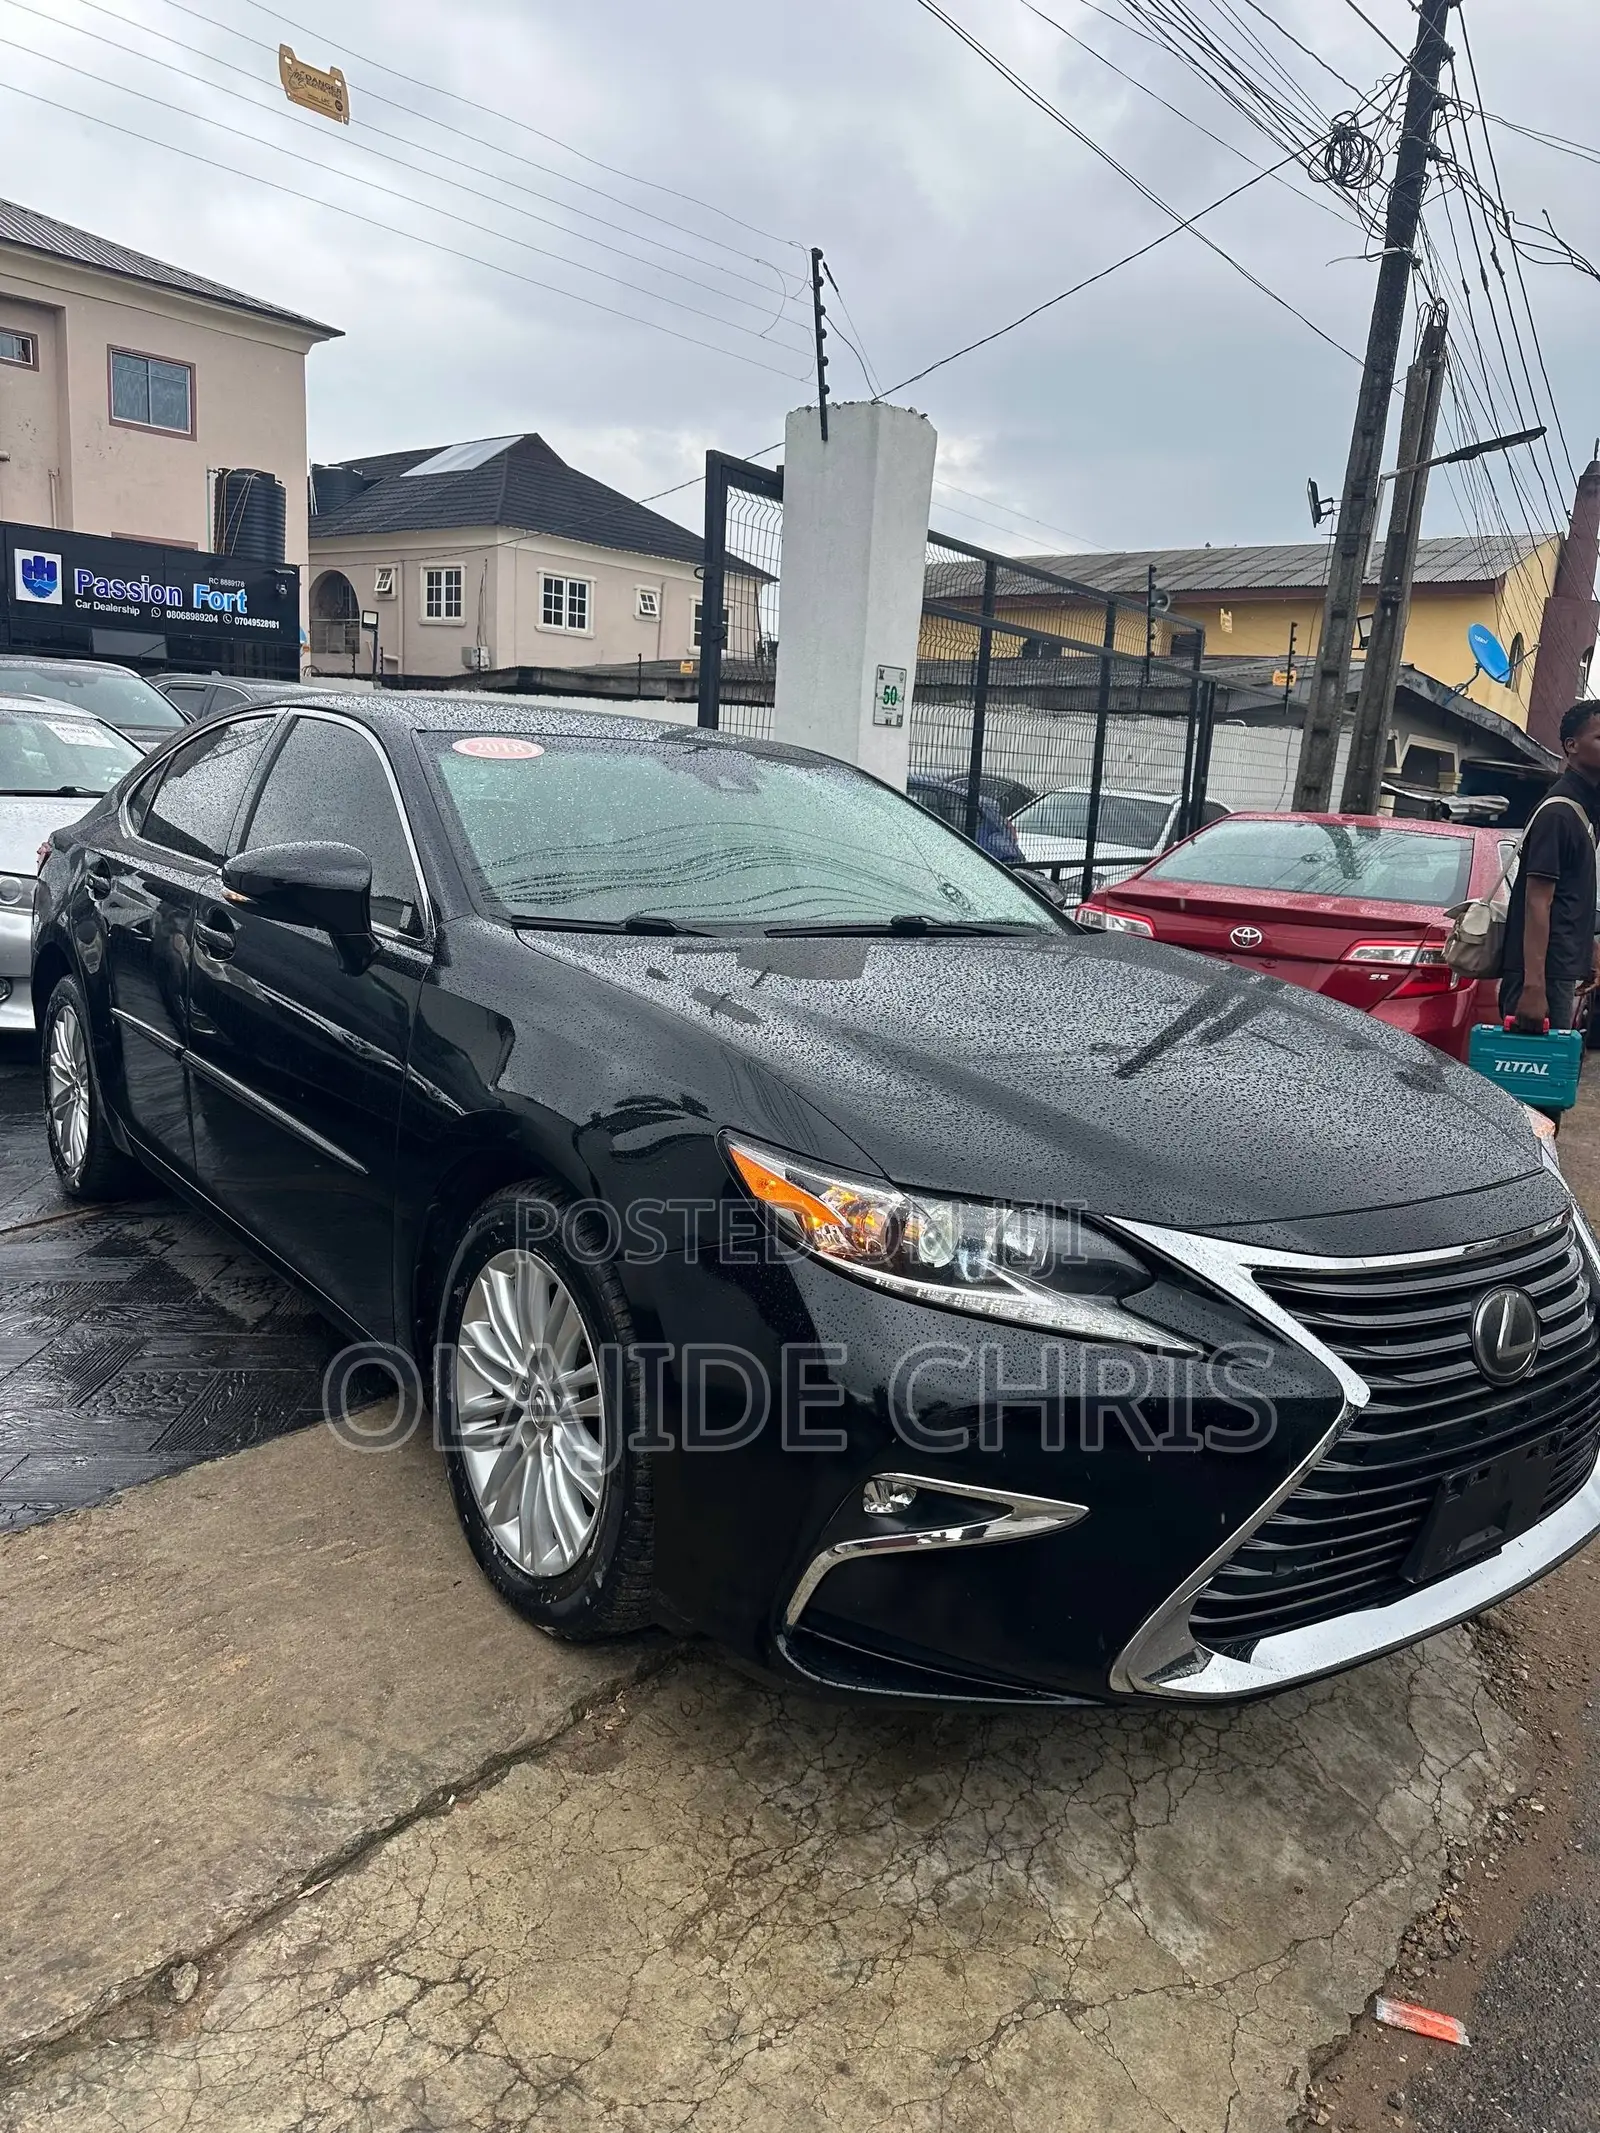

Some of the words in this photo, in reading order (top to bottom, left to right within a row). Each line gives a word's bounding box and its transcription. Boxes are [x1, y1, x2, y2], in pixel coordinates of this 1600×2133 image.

[305, 75, 342, 95] DANGER
[208, 577, 219, 585] RC
[74, 568, 183, 607] Passion
[193, 583, 248, 614] Fort
[75, 599, 92, 609] Car
[93, 601, 140, 616] Dealership
[166, 610, 219, 623] 08068989204
[234, 616, 280, 629] 07049528181
[882, 684, 898, 706] 50
[1494, 1060, 1550, 1076] TOTAL
